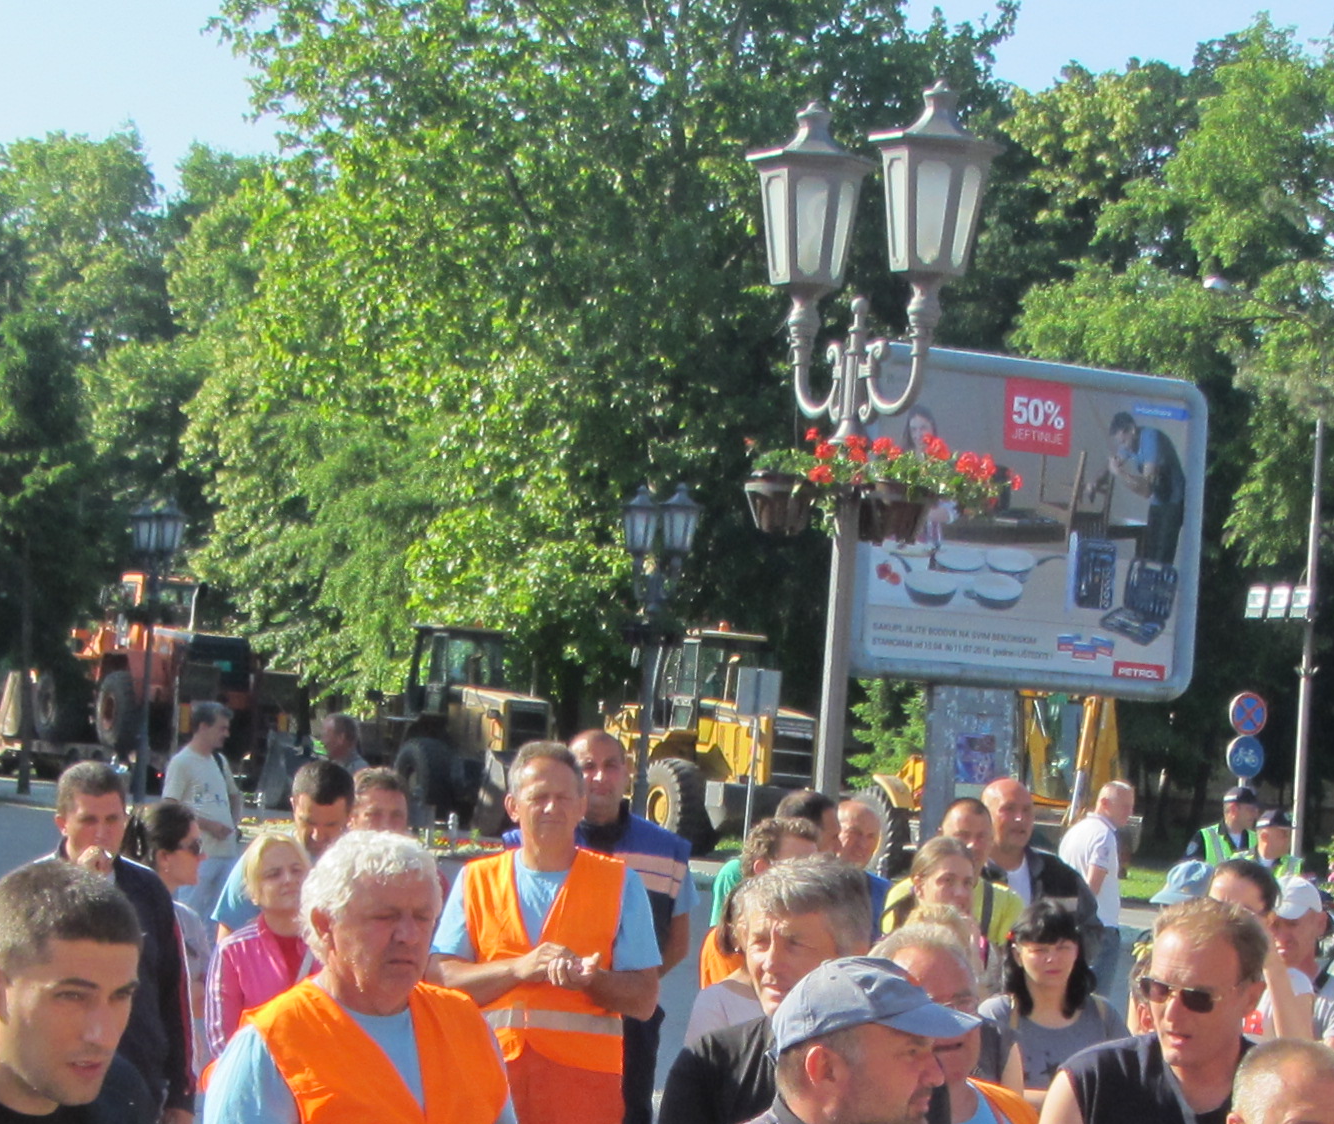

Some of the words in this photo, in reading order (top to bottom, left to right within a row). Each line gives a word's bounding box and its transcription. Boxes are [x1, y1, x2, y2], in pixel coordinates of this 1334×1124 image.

[1013, 396, 1065, 430] 50%
[1012, 428, 1063, 445] JEFTINIJE
[1118, 667, 1160, 680] PETROL
